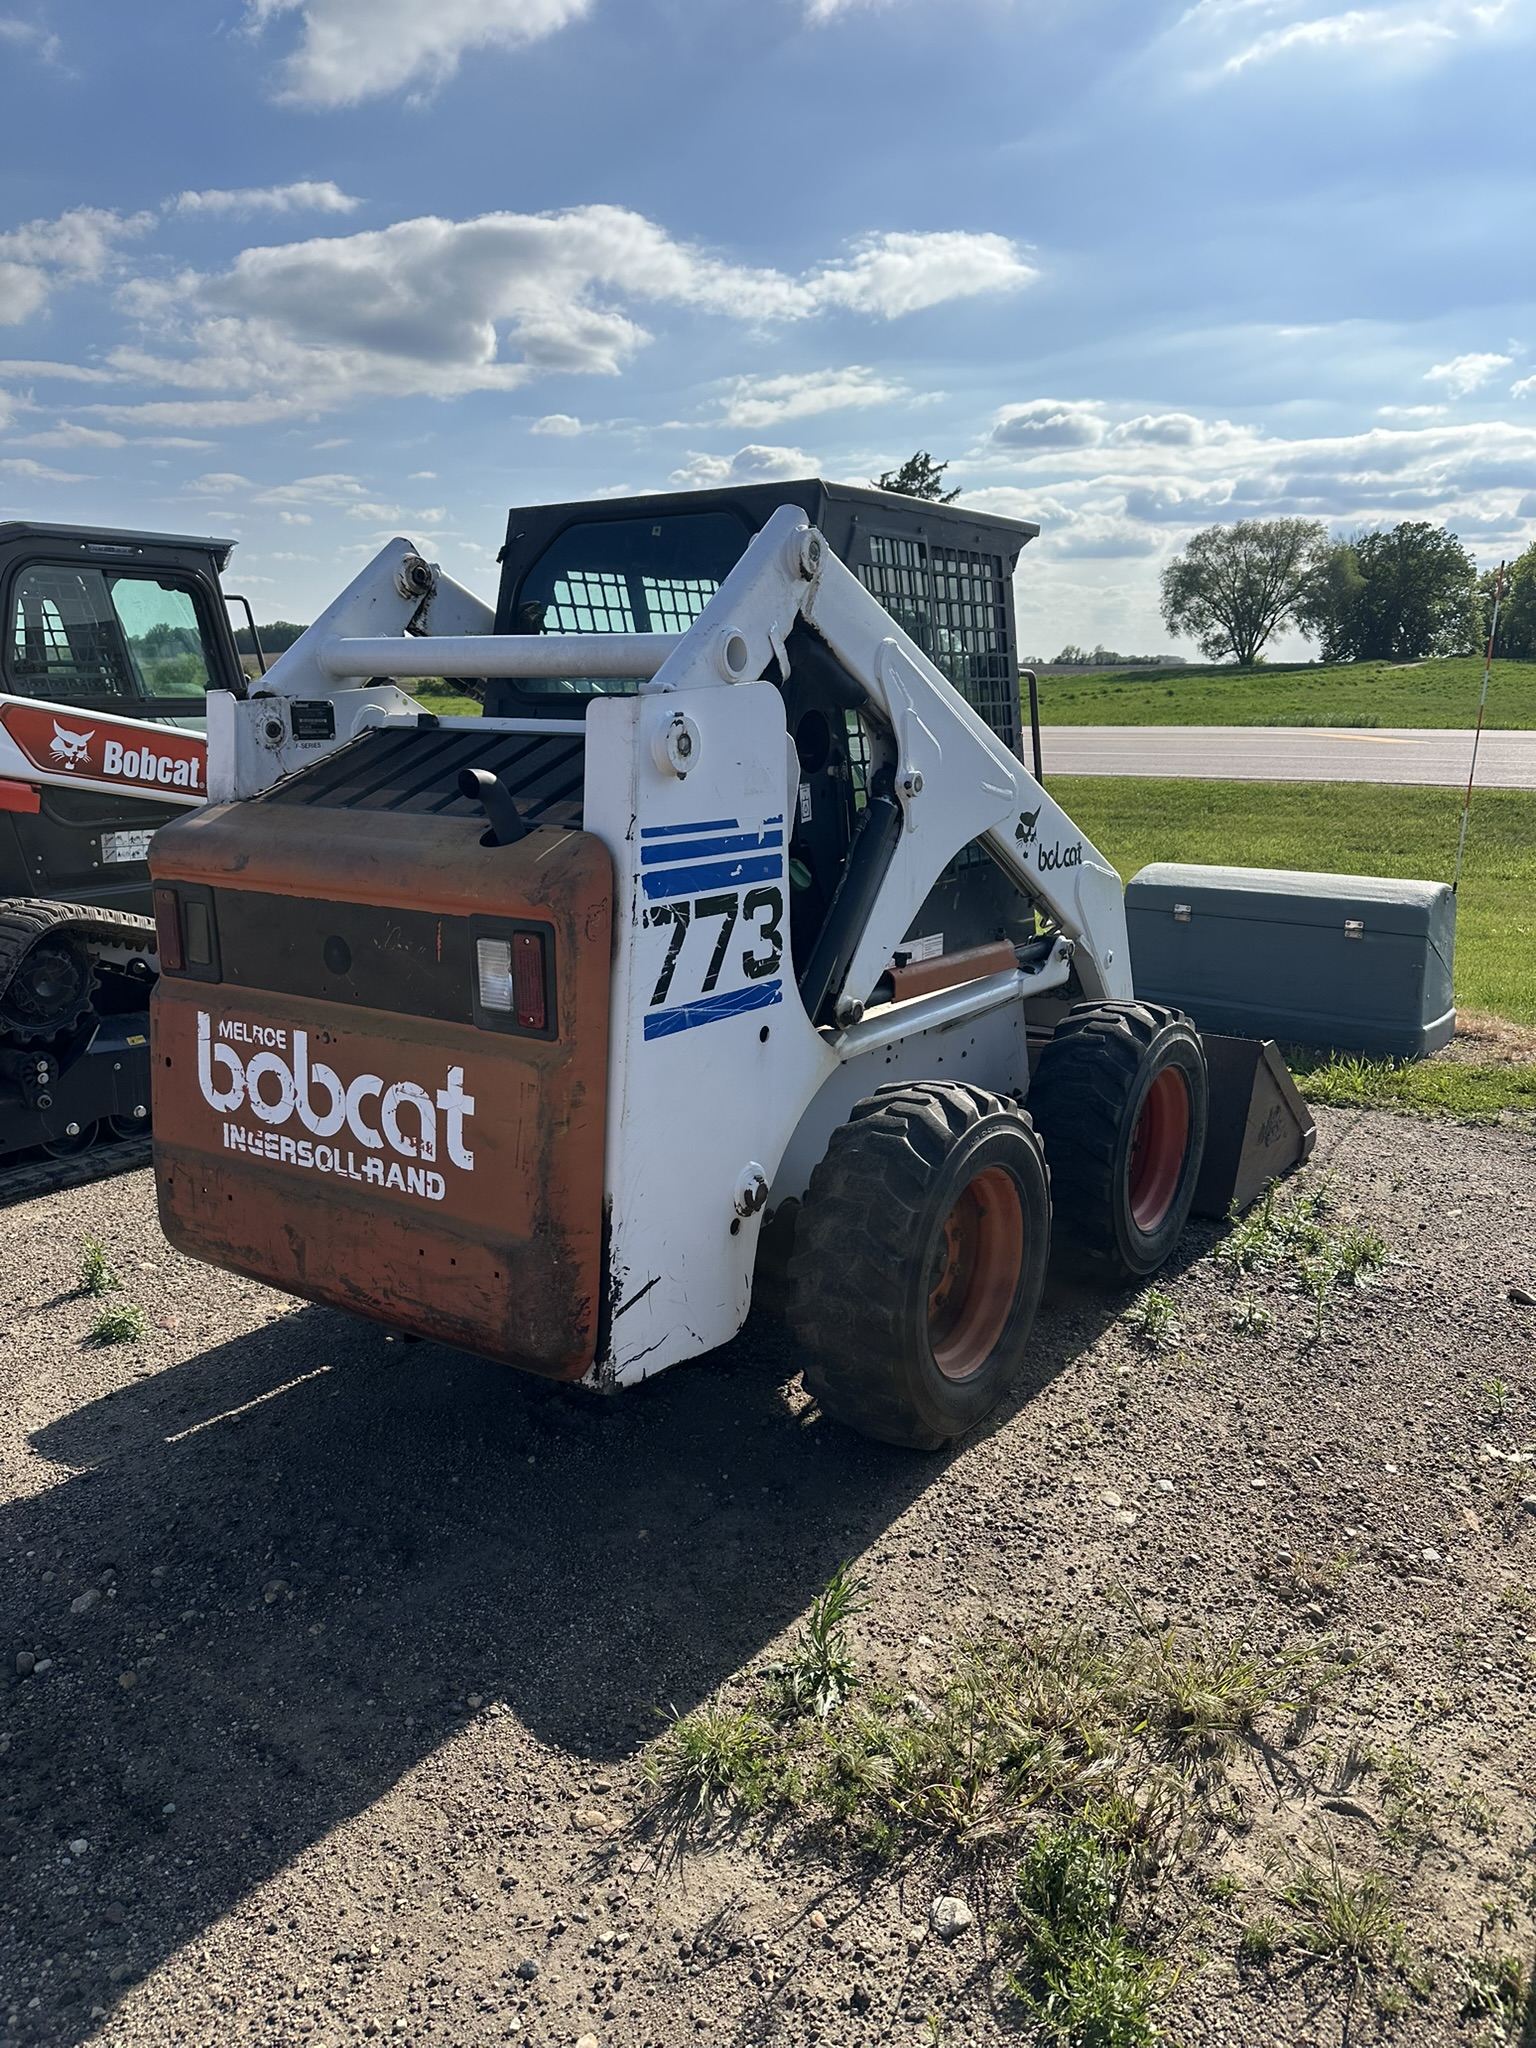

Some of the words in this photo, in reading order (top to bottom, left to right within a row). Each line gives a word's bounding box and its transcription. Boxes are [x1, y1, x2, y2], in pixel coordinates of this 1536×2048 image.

[103, 740, 200, 788] Bobcat
[642, 886, 783, 1007] 773
[218, 1020, 287, 1050] MELROE
[198, 1010, 475, 1171] bobcat
[223, 1122, 446, 1201] INGERSOLL-RAND
